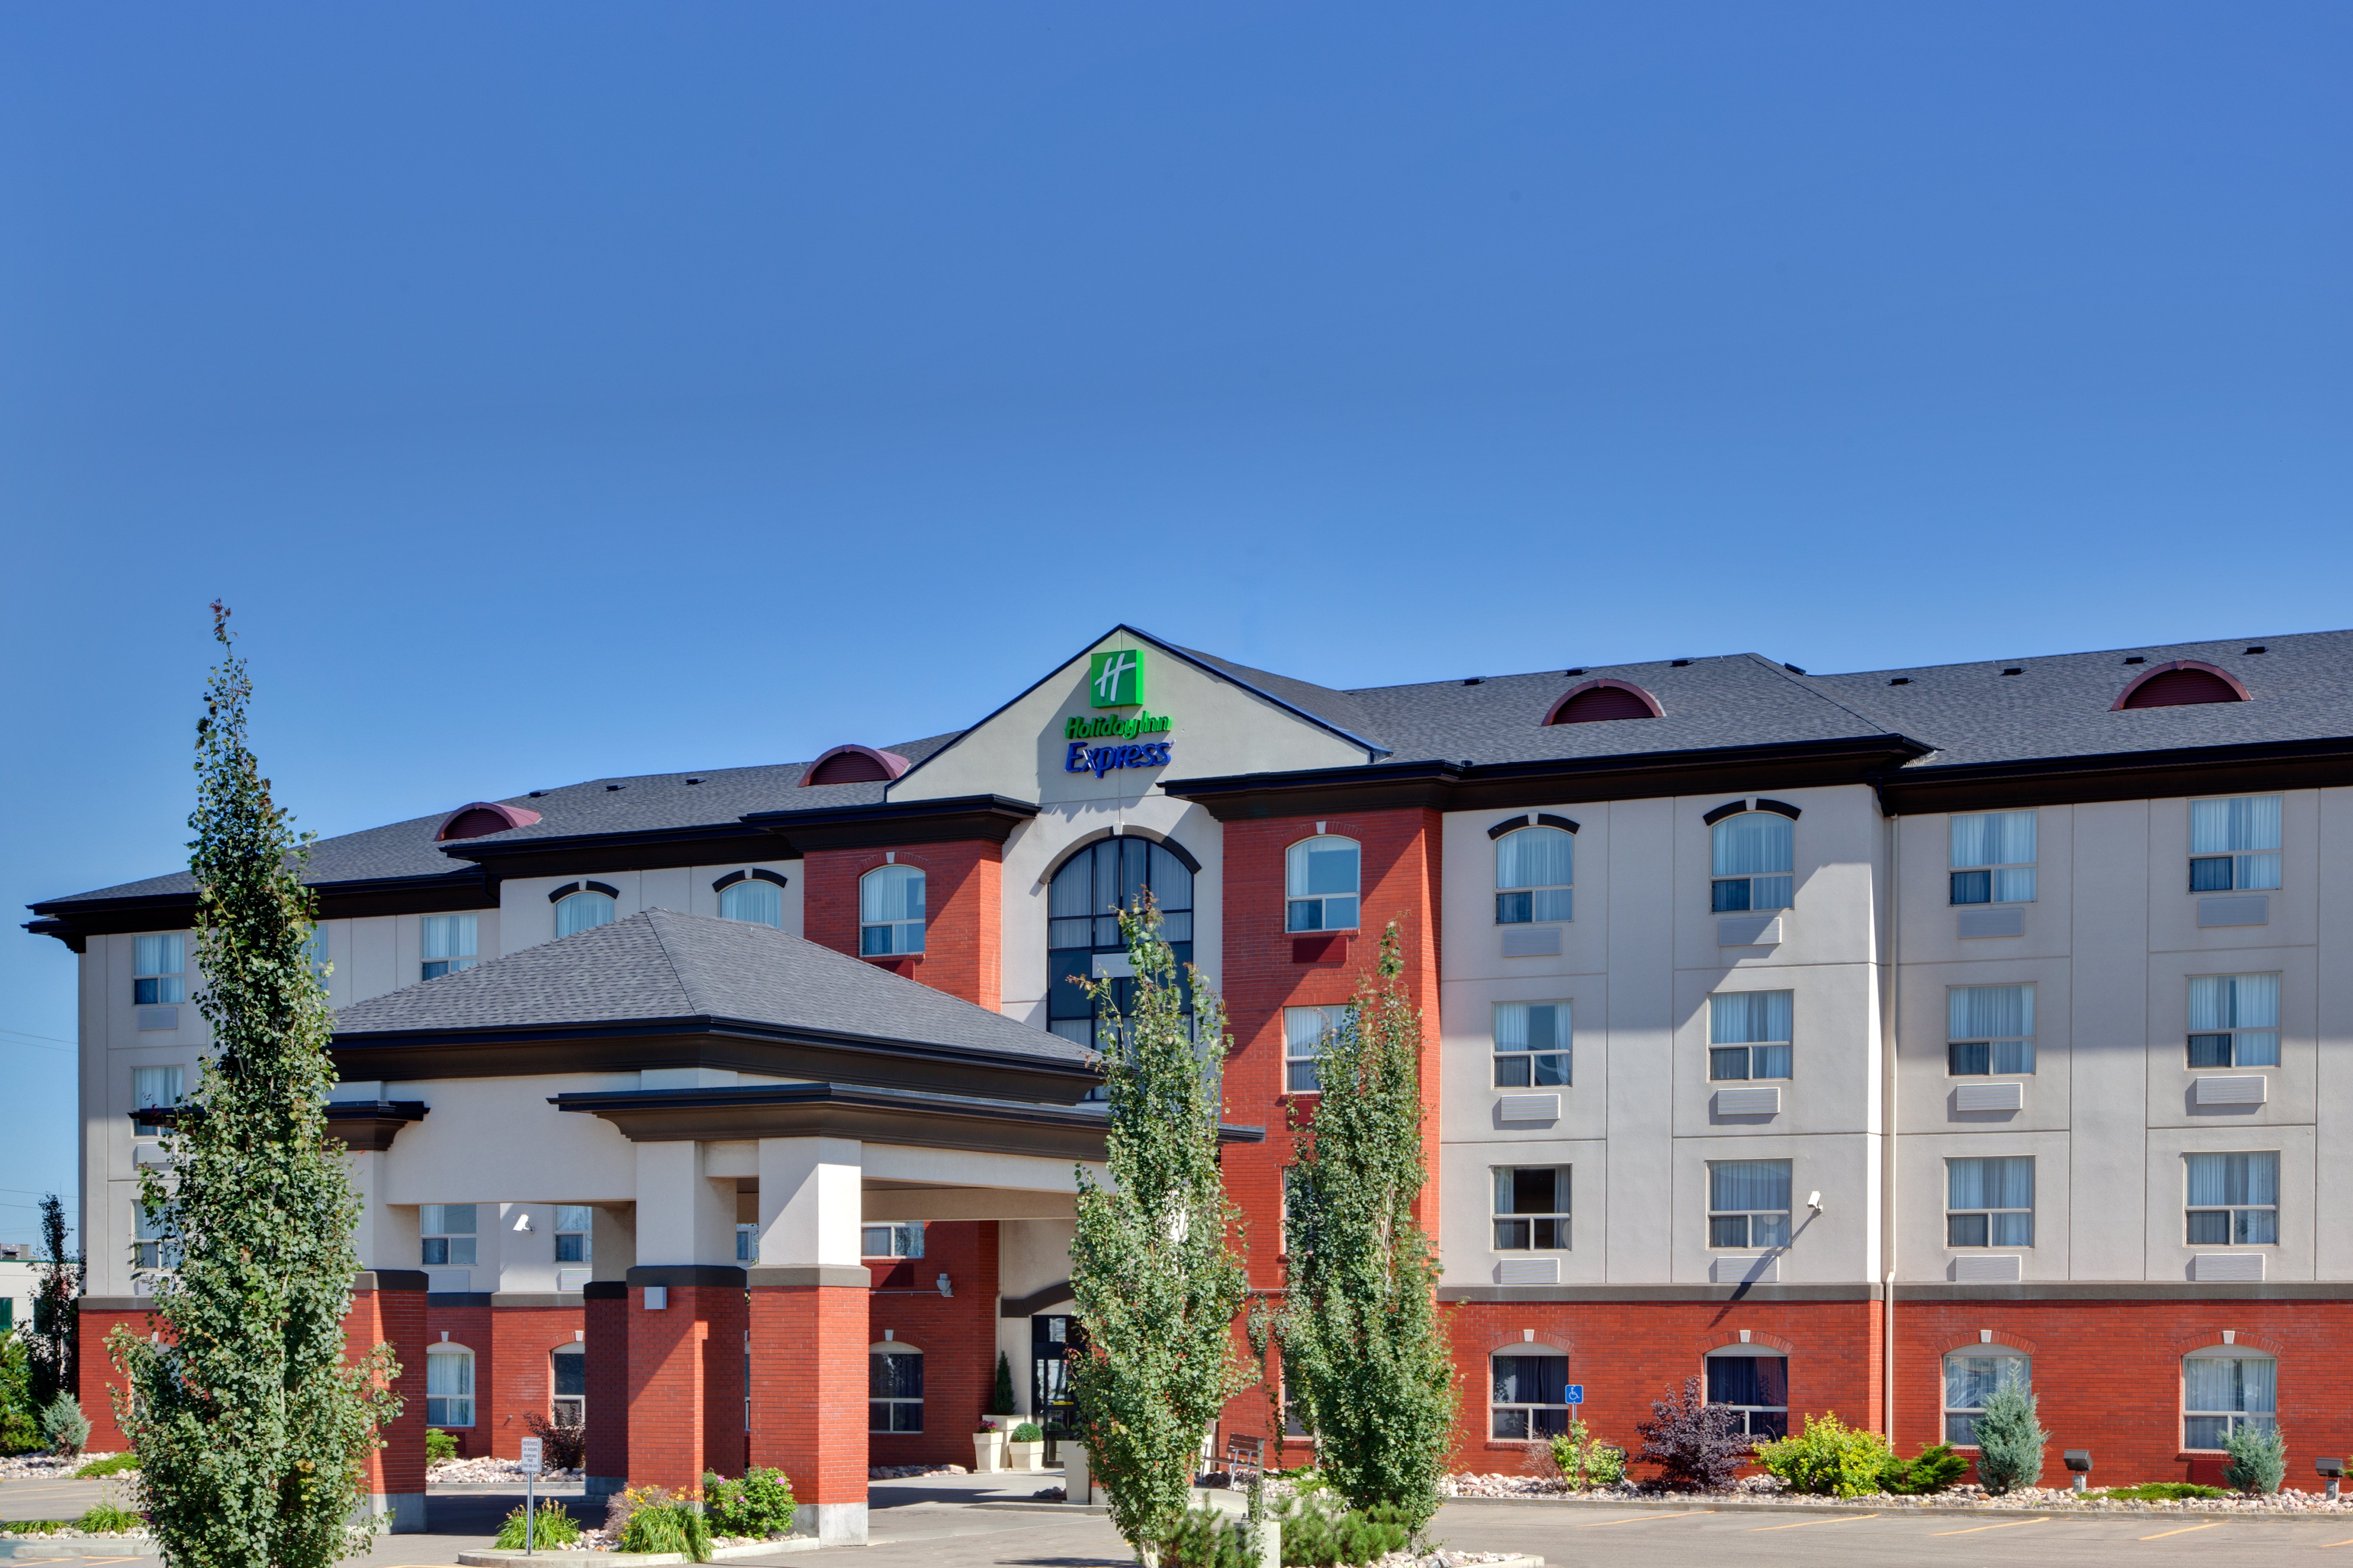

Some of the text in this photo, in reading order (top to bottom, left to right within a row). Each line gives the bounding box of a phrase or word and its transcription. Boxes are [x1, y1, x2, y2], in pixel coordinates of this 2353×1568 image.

[1064, 711, 1173, 739] Holiday Inn
[1065, 742, 1172, 779] Express
